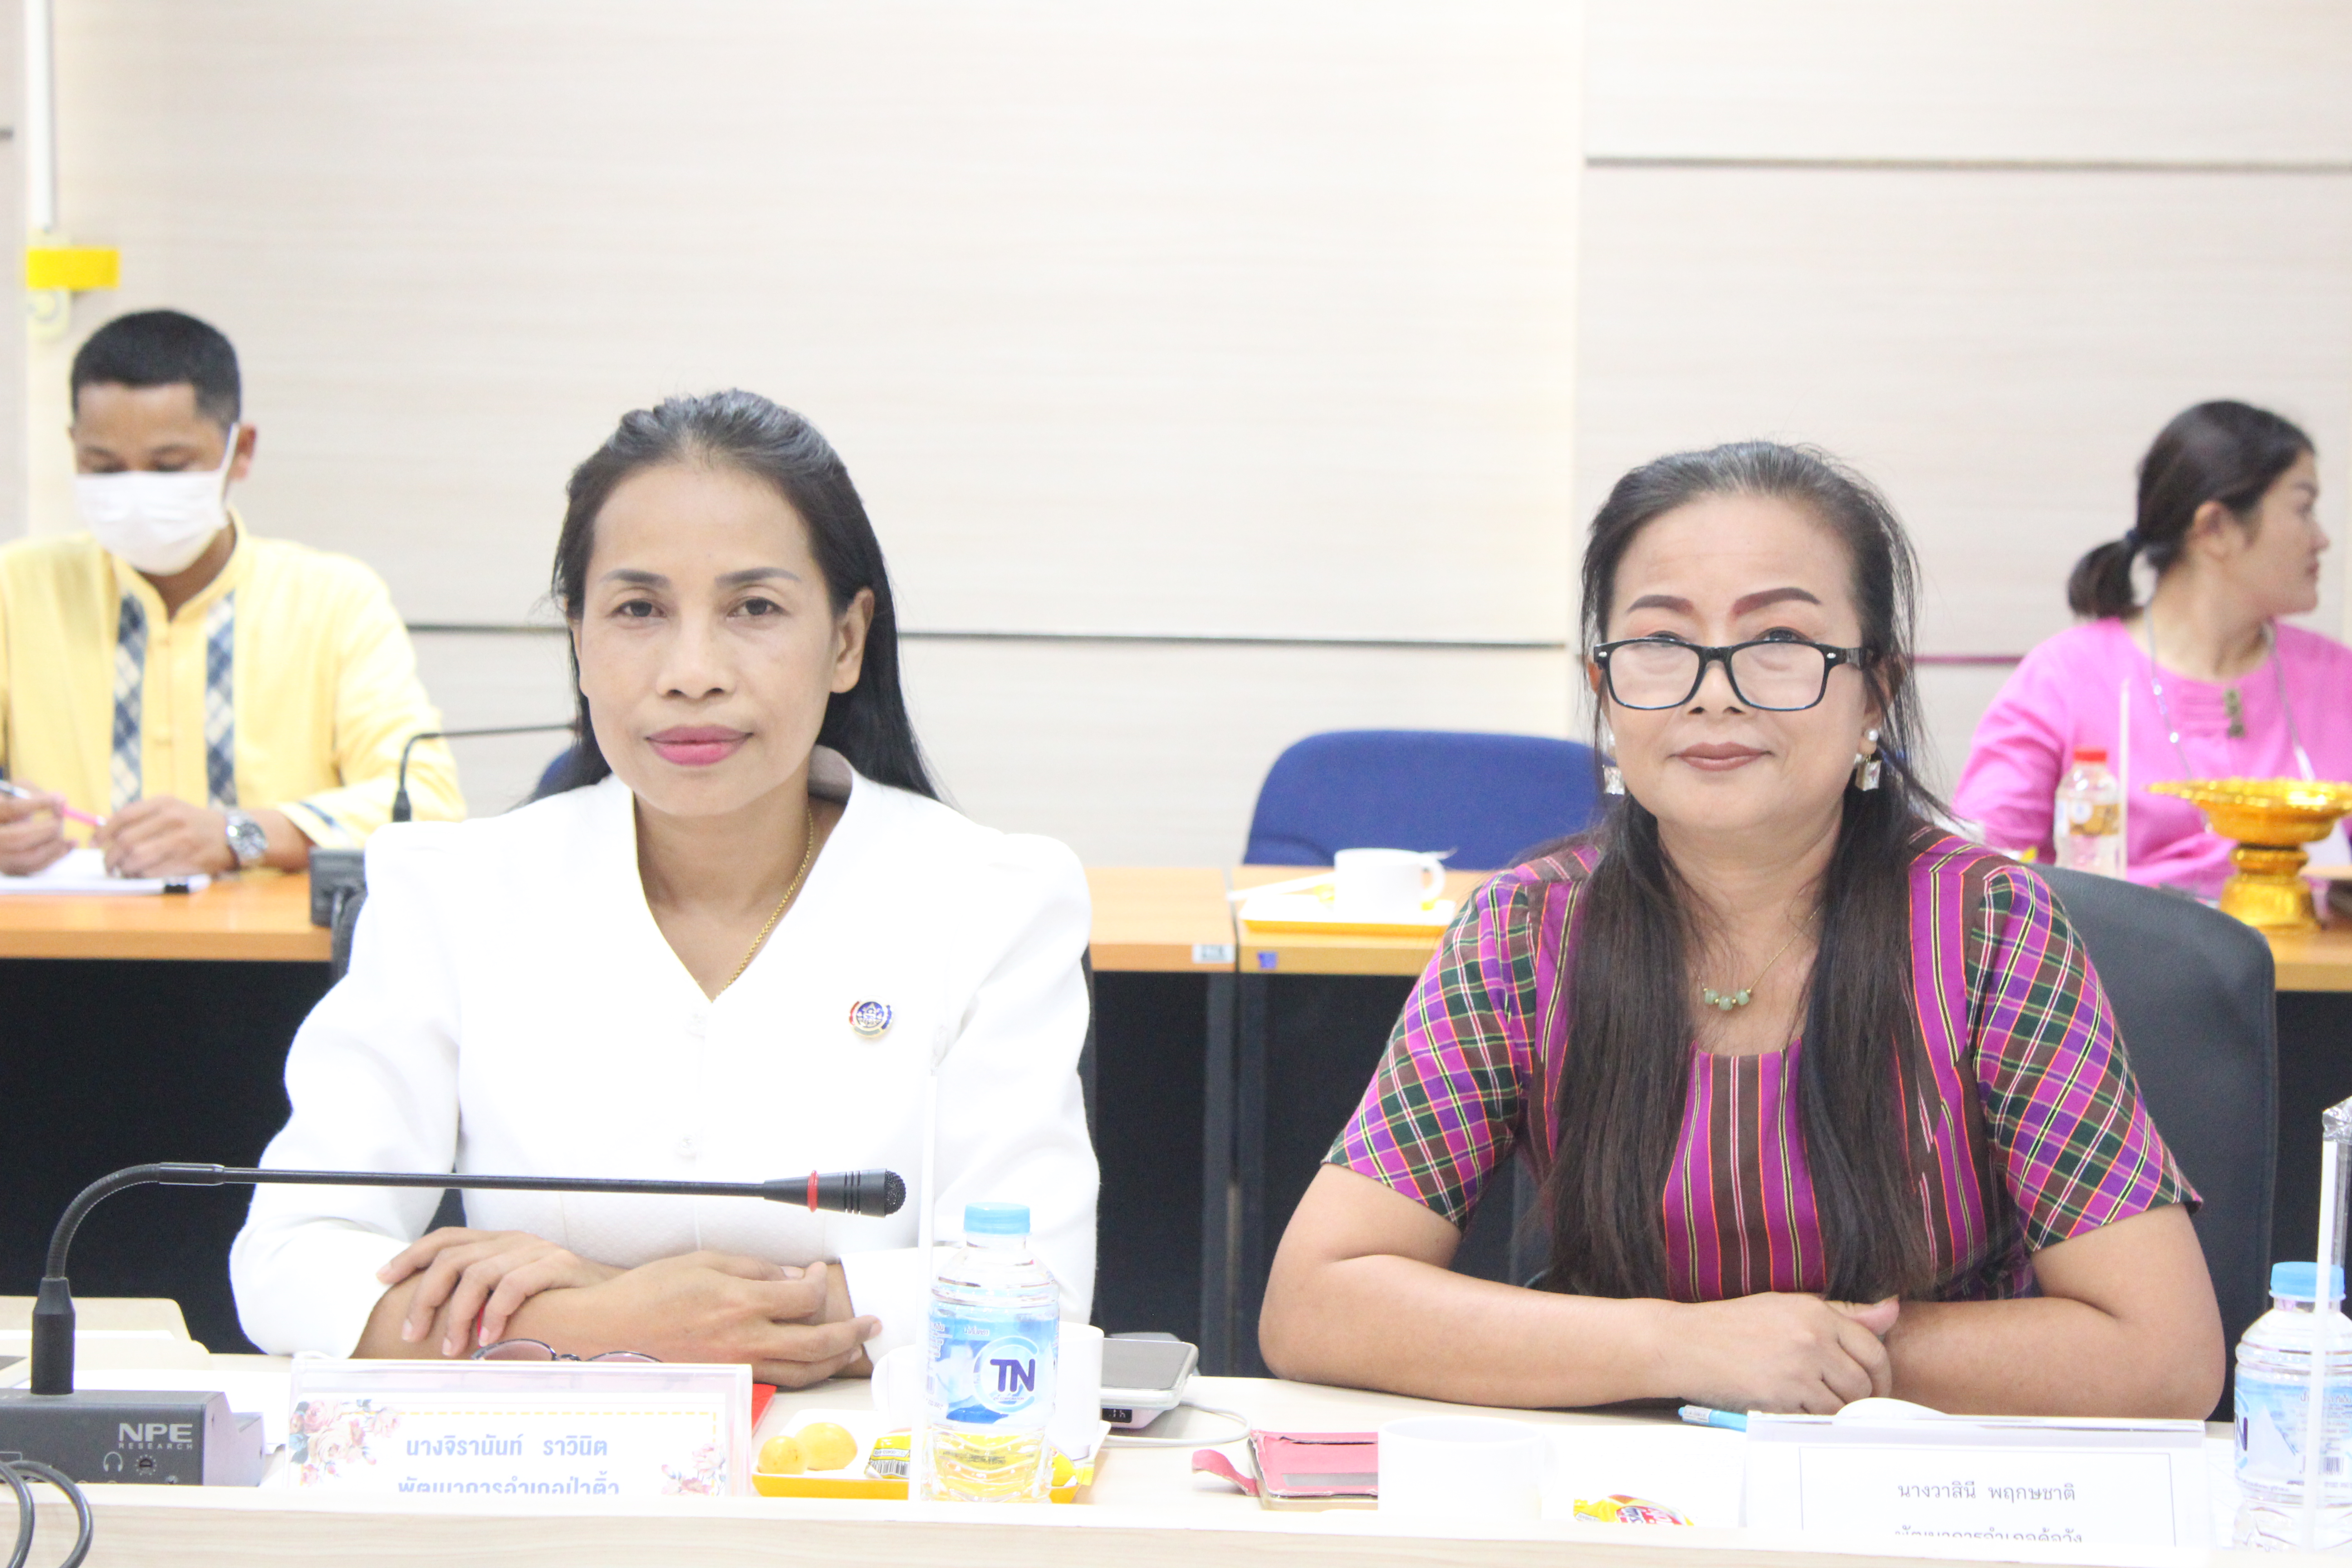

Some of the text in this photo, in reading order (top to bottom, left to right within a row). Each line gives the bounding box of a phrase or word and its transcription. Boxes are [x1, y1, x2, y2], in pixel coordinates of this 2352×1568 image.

[989, 1358, 1036, 1392] TN
[119, 1423, 193, 1442] NPE
[118, 1442, 193, 1450] RESEARCH
[407, 1433, 608, 1456] นางจิรานันท์ ราวินิต
[1898, 1480, 2076, 1504] นางวาสินี พฤกษชาติ
